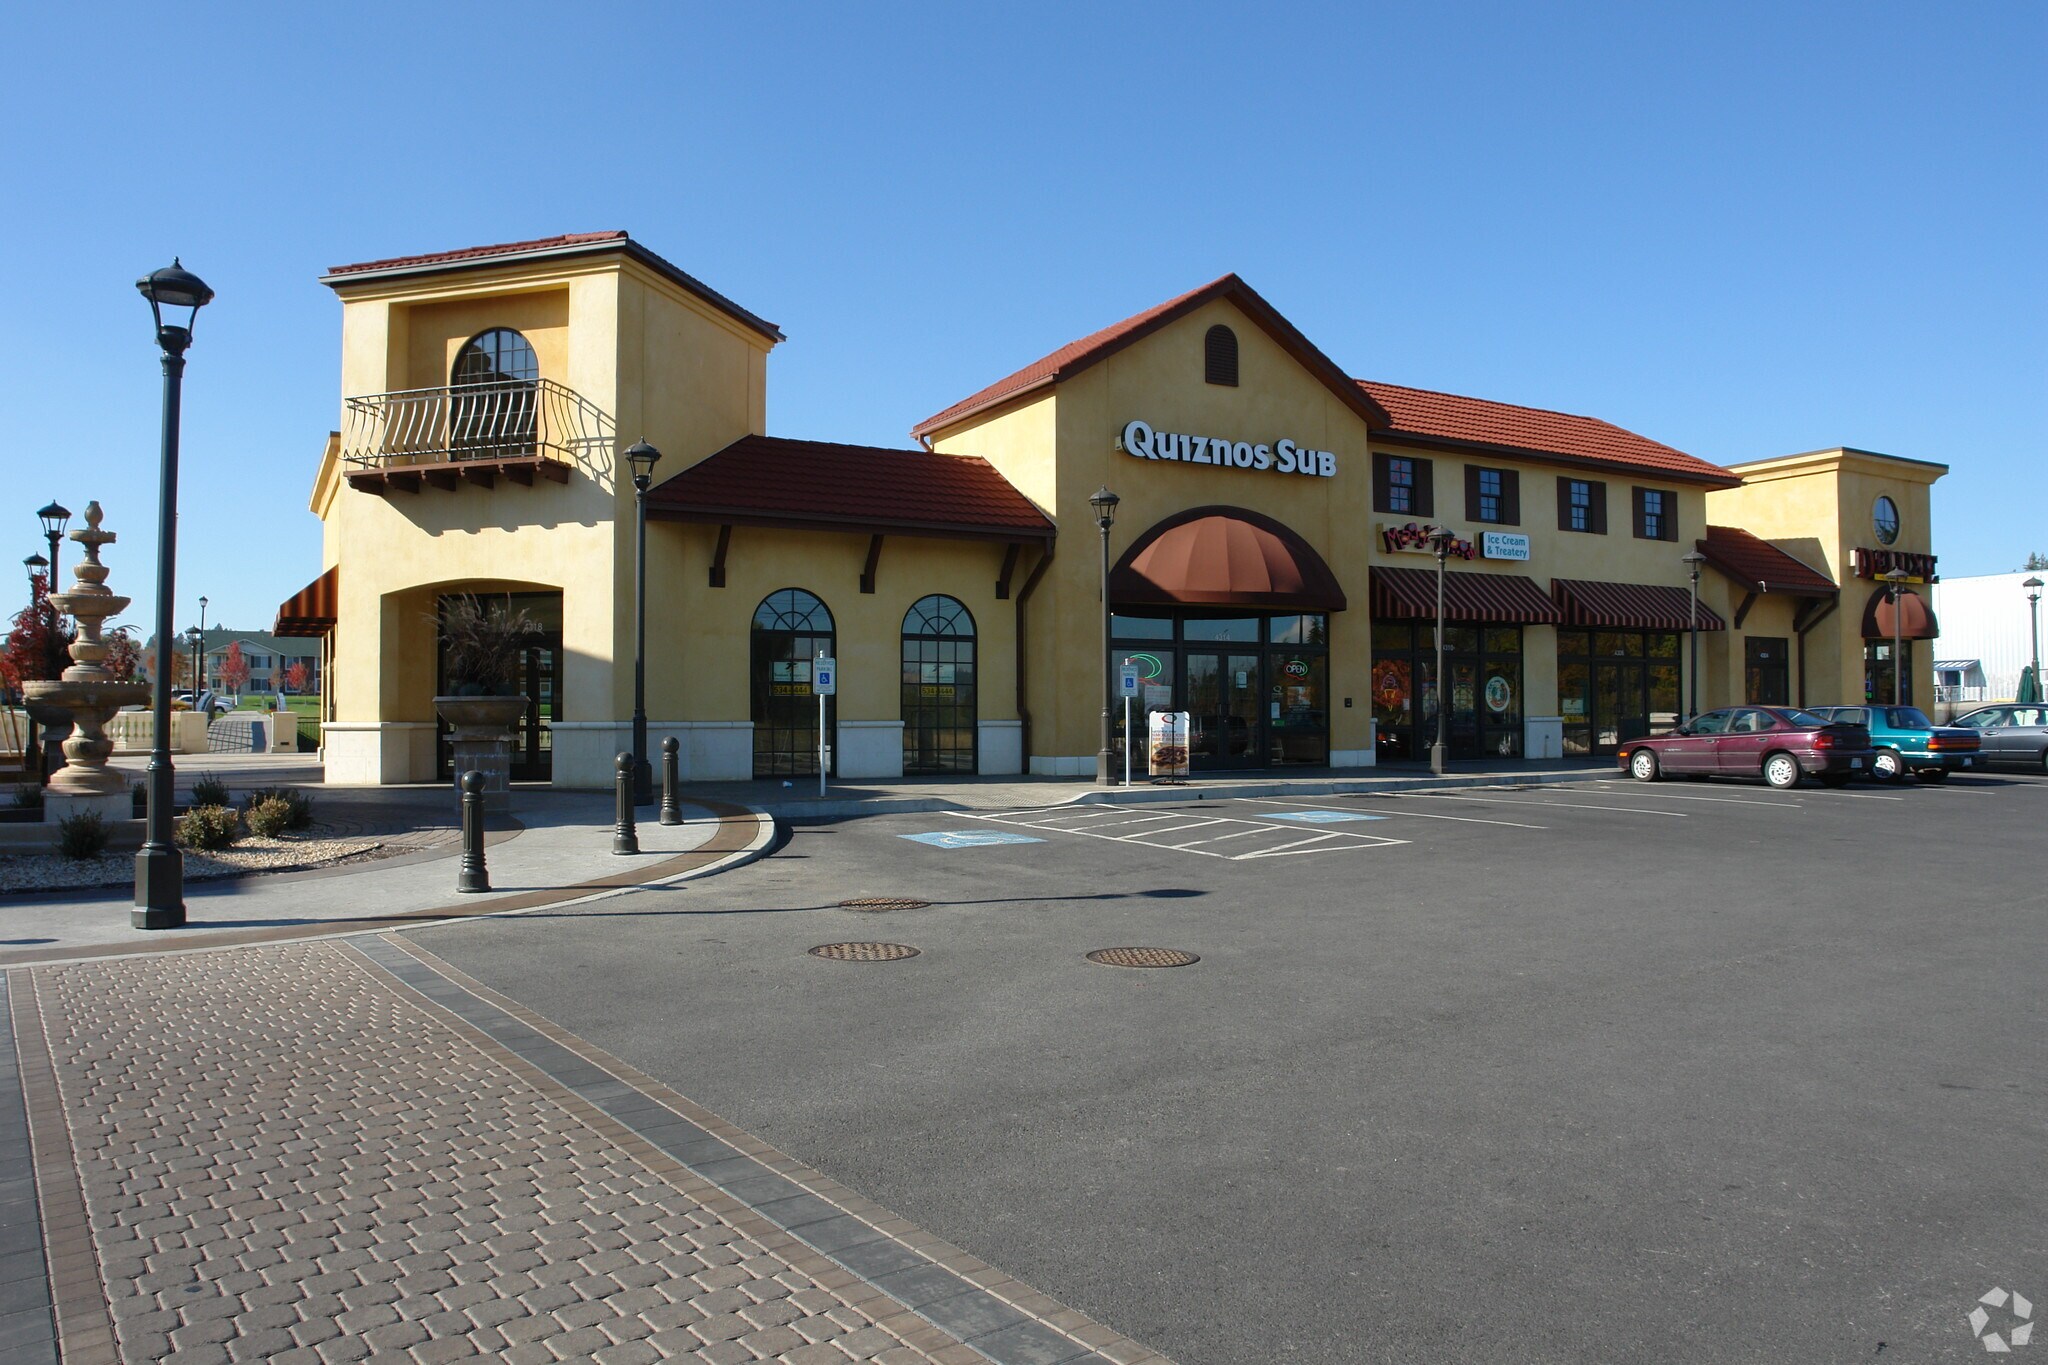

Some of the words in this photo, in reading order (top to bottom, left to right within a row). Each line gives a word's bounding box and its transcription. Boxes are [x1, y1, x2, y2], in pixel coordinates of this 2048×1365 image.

[1487, 534, 1500, 544] Ice
[1501, 535, 1526, 546] Cream
[1486, 545, 1493, 555] &
[1494, 545, 1528, 559] Treatery
[1286, 664, 1305, 673] OPEN
